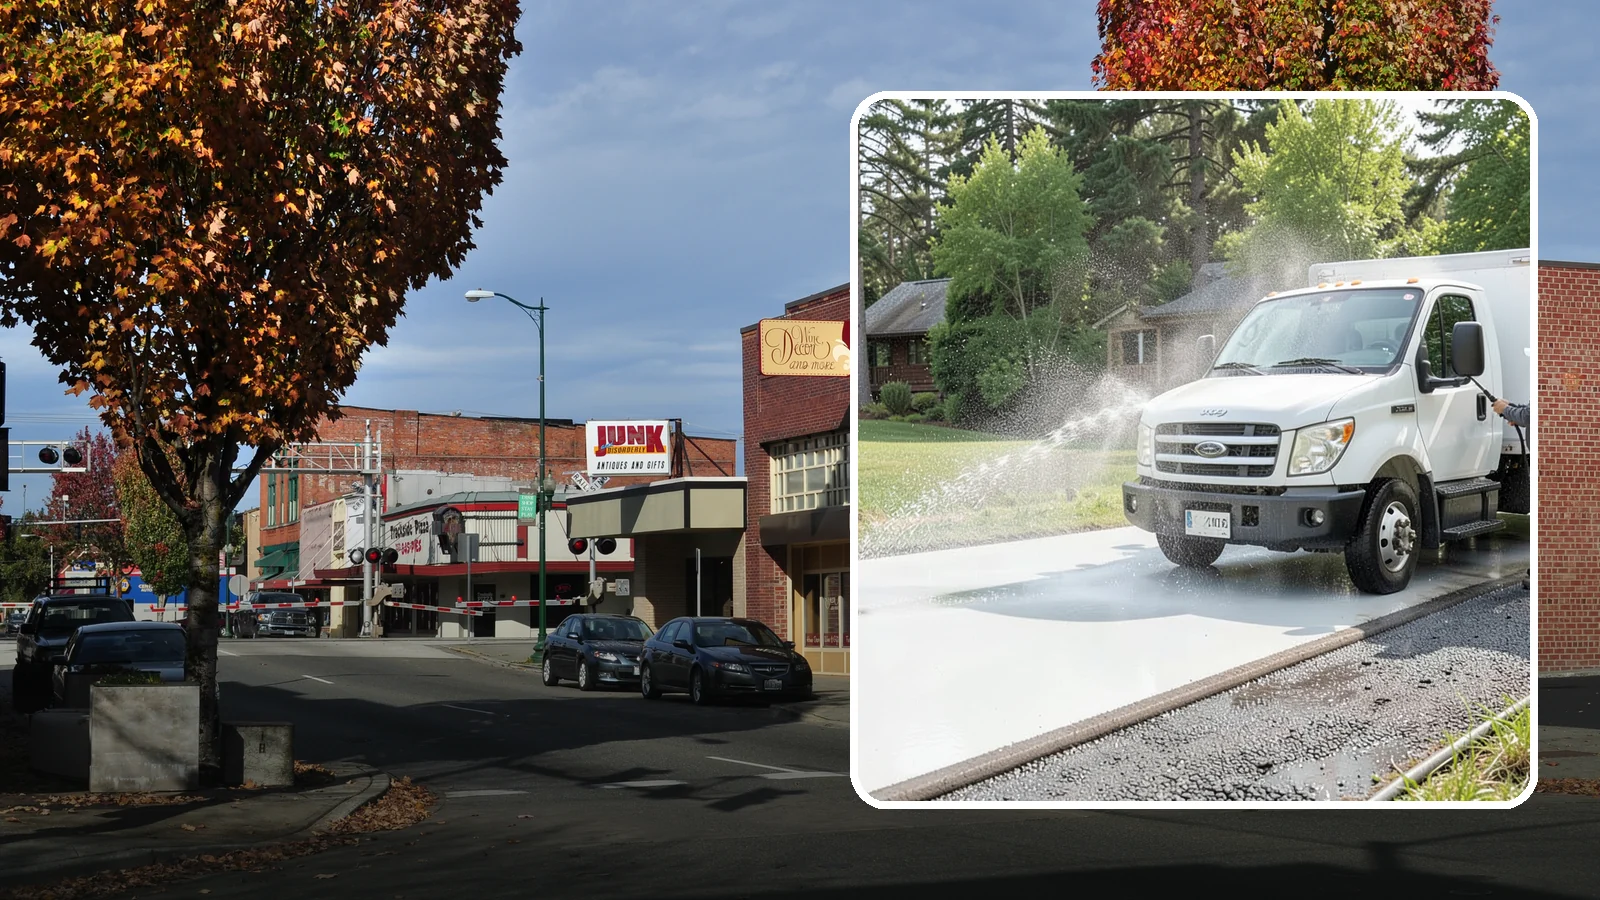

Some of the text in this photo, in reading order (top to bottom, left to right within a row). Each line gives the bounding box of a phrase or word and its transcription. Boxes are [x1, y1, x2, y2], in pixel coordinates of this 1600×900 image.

[765, 328, 830, 365] Decor
[595, 425, 665, 457] JUNK
[597, 461, 665, 470] ANTIQUES AND GIFTS
[390, 519, 429, 539] Trackside Pizza
